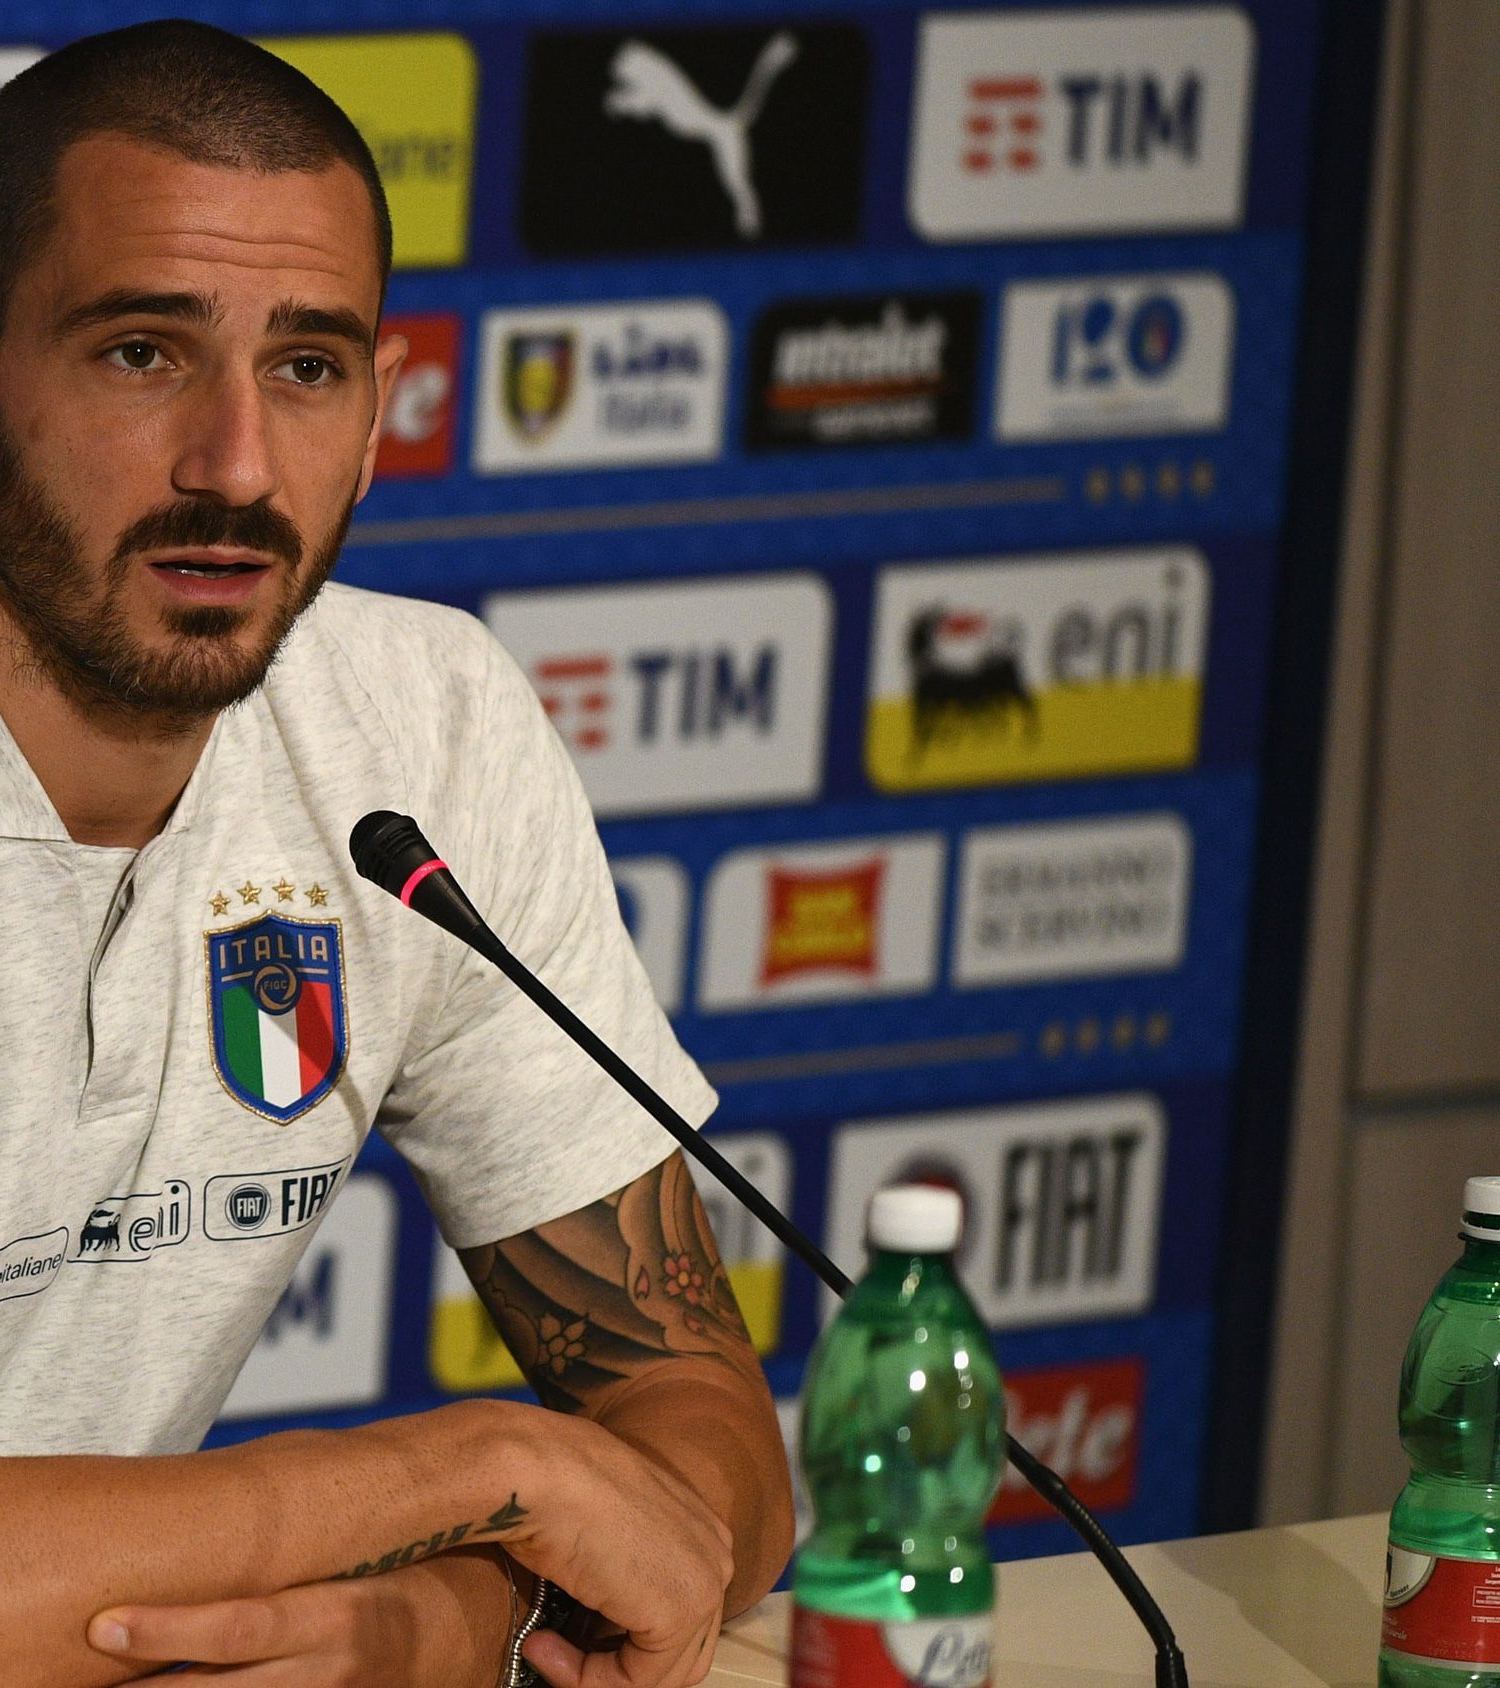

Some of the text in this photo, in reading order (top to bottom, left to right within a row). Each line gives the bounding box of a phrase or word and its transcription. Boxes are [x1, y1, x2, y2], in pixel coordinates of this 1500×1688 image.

[1058, 68, 1202, 170] TIM
[1047, 562, 1190, 690] eni
[629, 640, 777, 747] TIM
[219, 933, 329, 970] ITALIA
[263, 979, 289, 991] FIGC
[235, 1195, 263, 1218] FIAT
[996, 1124, 1147, 1292] FIAT
